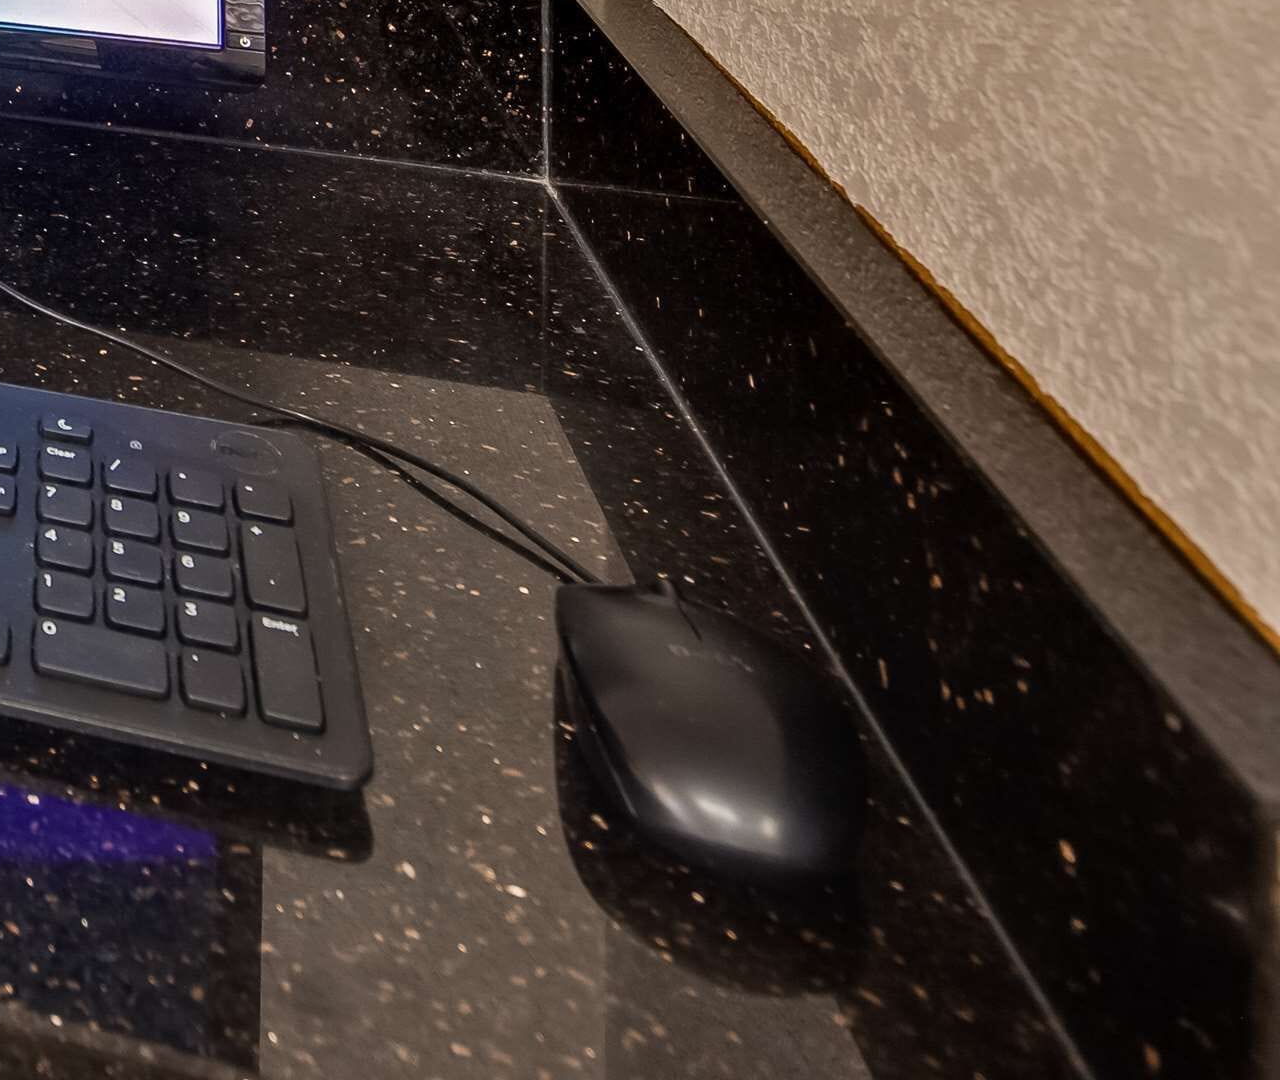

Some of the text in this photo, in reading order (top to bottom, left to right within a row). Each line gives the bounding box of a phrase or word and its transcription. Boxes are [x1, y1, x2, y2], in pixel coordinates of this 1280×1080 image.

[47, 447, 75, 458] Clear
[46, 486, 56, 497] 7
[111, 499, 122, 510] 8
[178, 511, 190, 522] 9
[45, 529, 57, 541] 4
[113, 542, 124, 554] 5
[182, 555, 194, 567] 6
[44, 574, 51, 586] 1
[114, 588, 125, 602] 2
[186, 602, 197, 616] 3
[43, 621, 56, 634] 0
[262, 617, 299, 636] Enter
